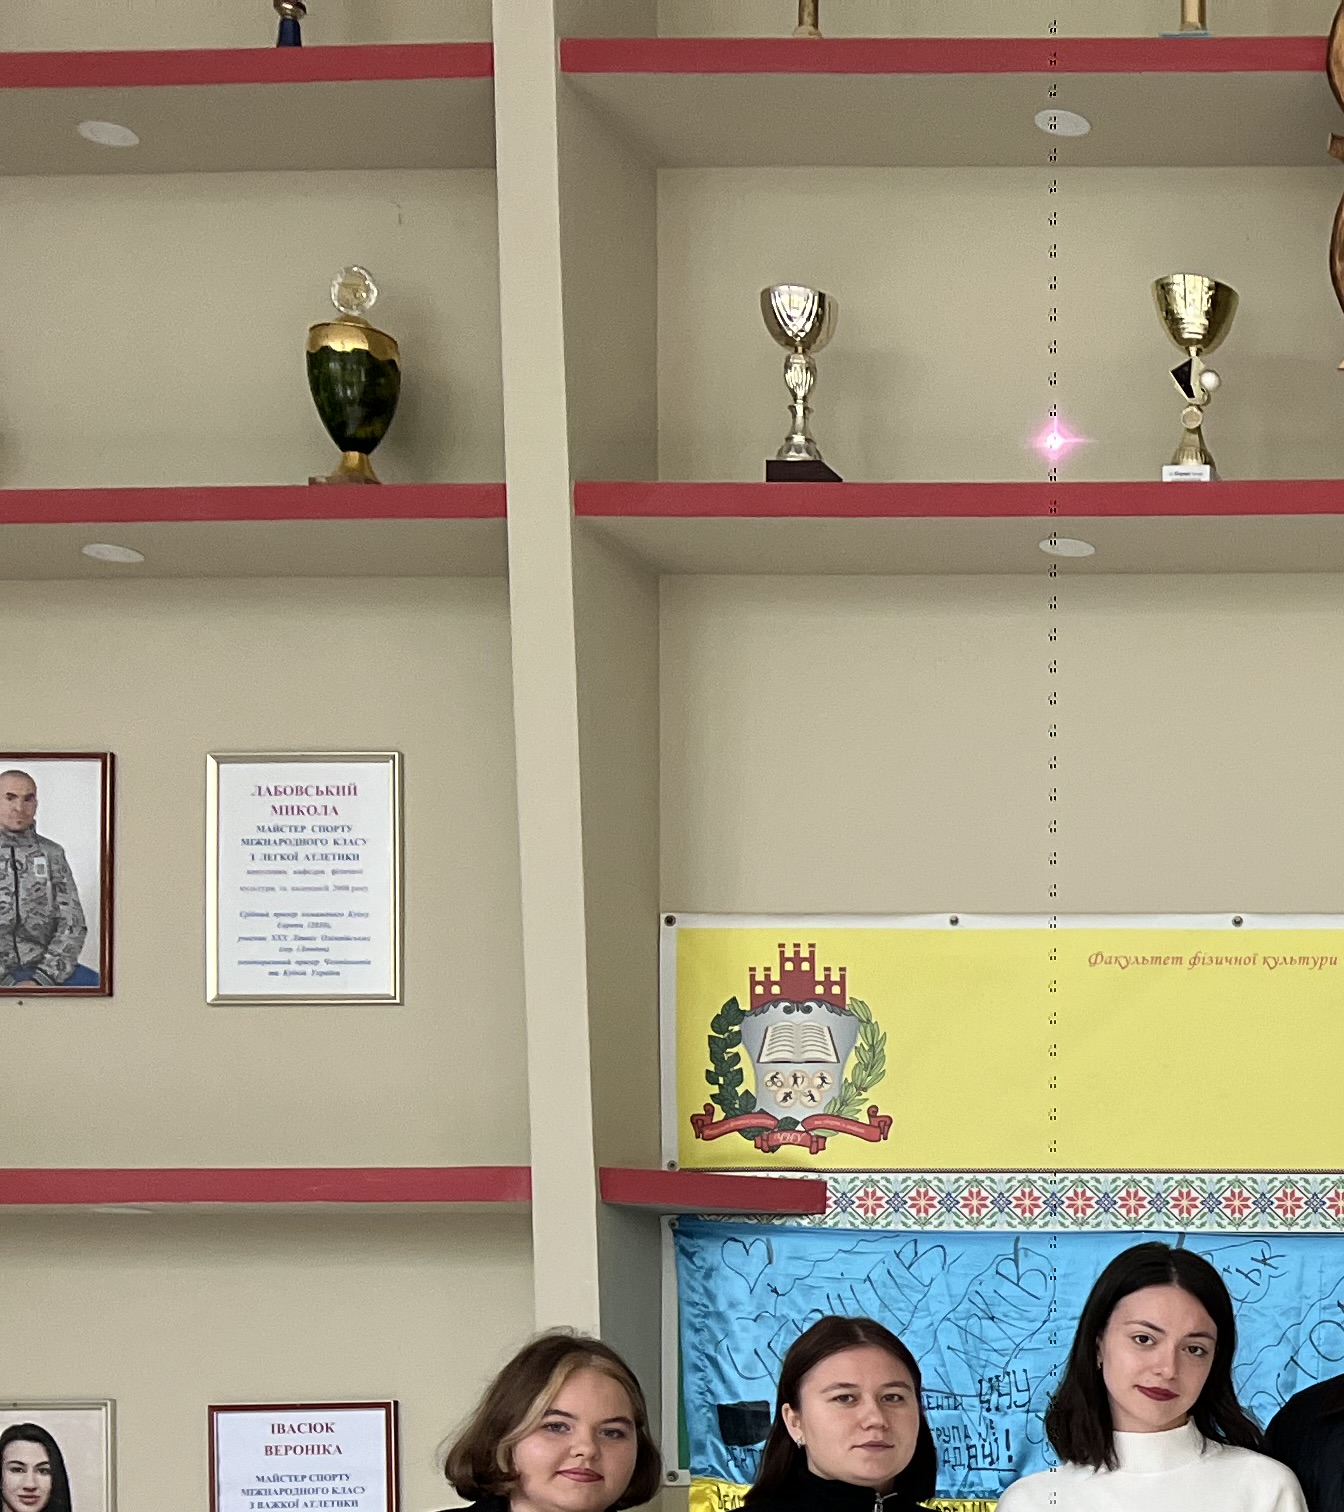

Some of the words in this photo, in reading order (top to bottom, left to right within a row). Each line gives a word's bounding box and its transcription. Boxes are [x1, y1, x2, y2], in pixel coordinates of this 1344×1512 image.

[251, 783, 358, 797] ЛАБОВСЬКИЙ
[271, 804, 339, 816] МИКОЛА
[256, 824, 307, 833] МАЙСТЕР
[311, 824, 353, 833] СПОРТУ
[1088, 950, 1184, 969] Факультет
[1188, 950, 1258, 970] фізичної
[1262, 953, 1338, 970] культури
[271, 1421, 336, 1435] ІВАСЮК
[264, 1444, 343, 1457] ВЕРОНІКА
[255, 1473, 307, 1483] МАЙСТЕР
[309, 1473, 351, 1483] СПОРТУ
[241, 1487, 329, 1497] МІЖНАРОДНОГО
[331, 1486, 367, 1495] КЛАСУ
